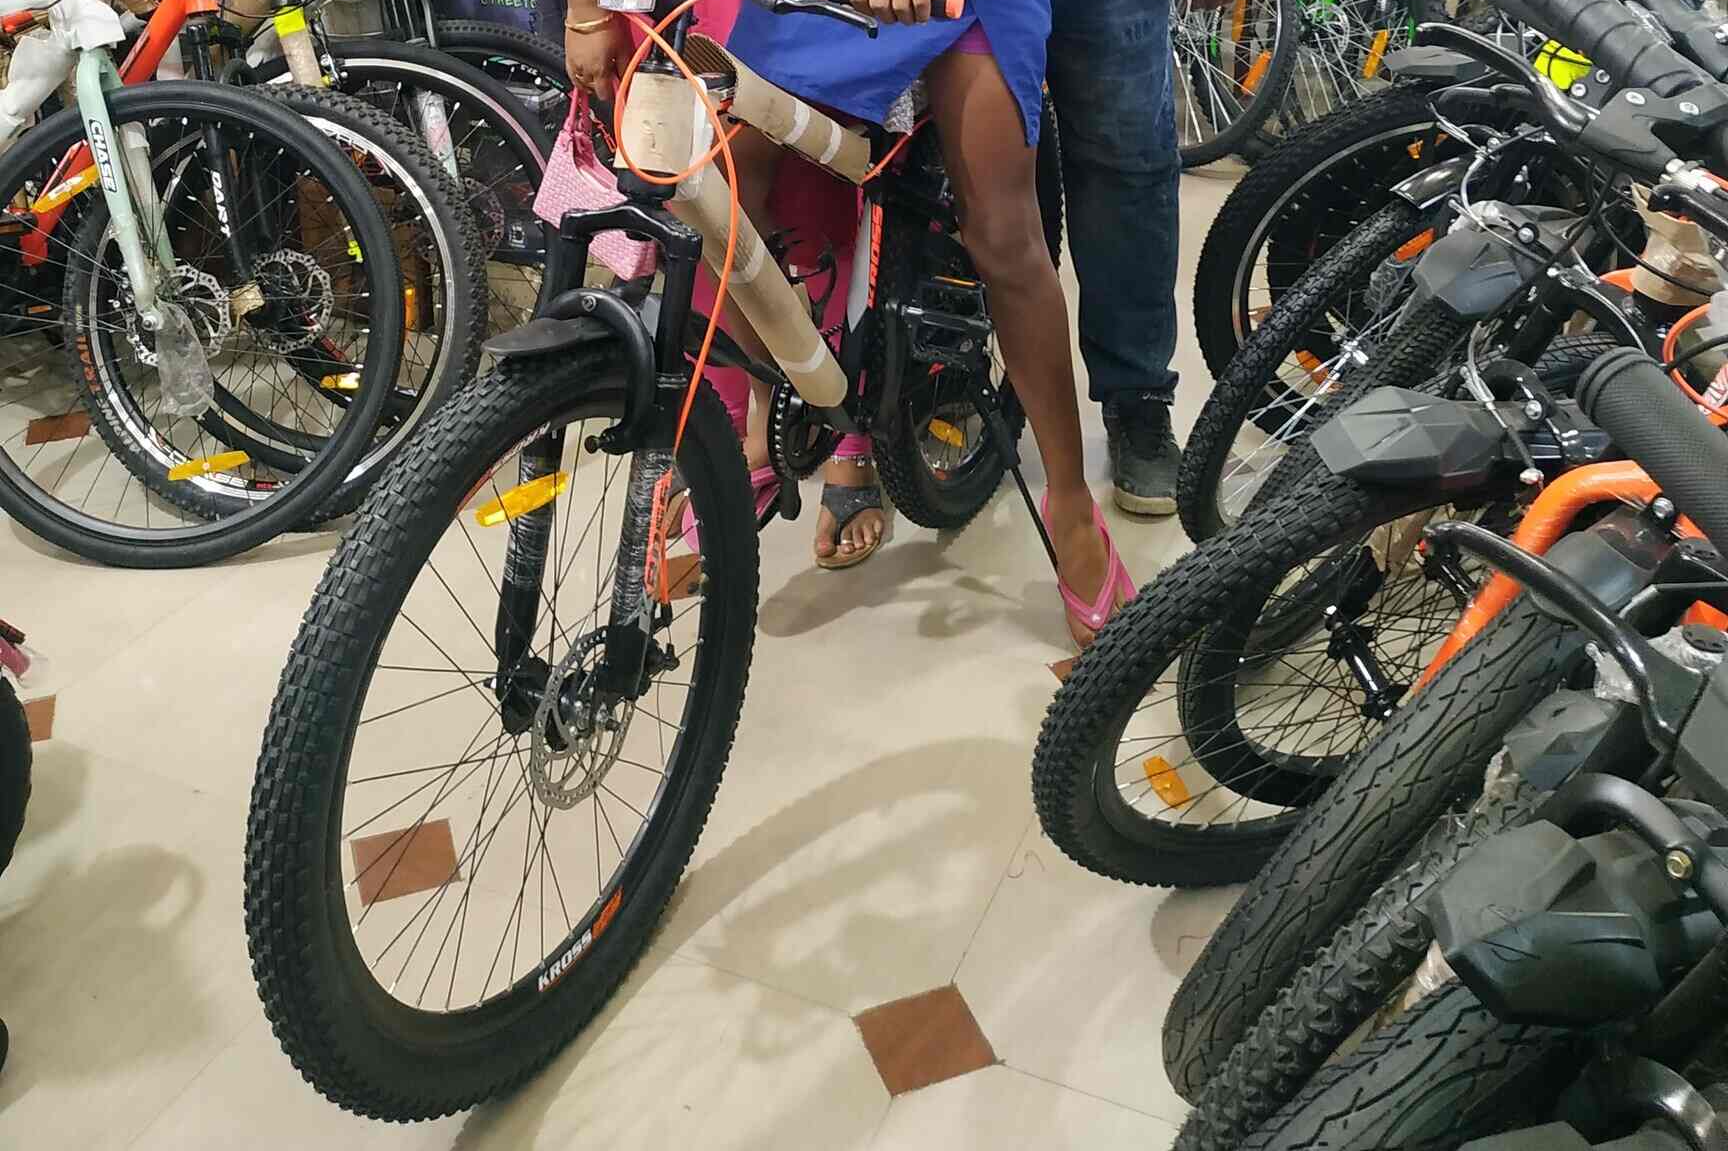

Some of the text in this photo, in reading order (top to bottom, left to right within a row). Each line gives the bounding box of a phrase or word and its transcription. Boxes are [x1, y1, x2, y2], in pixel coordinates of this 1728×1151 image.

[89, 119, 117, 193] CHASE
[867, 202, 884, 310] KROSS
[537, 927, 593, 993] KROSS
